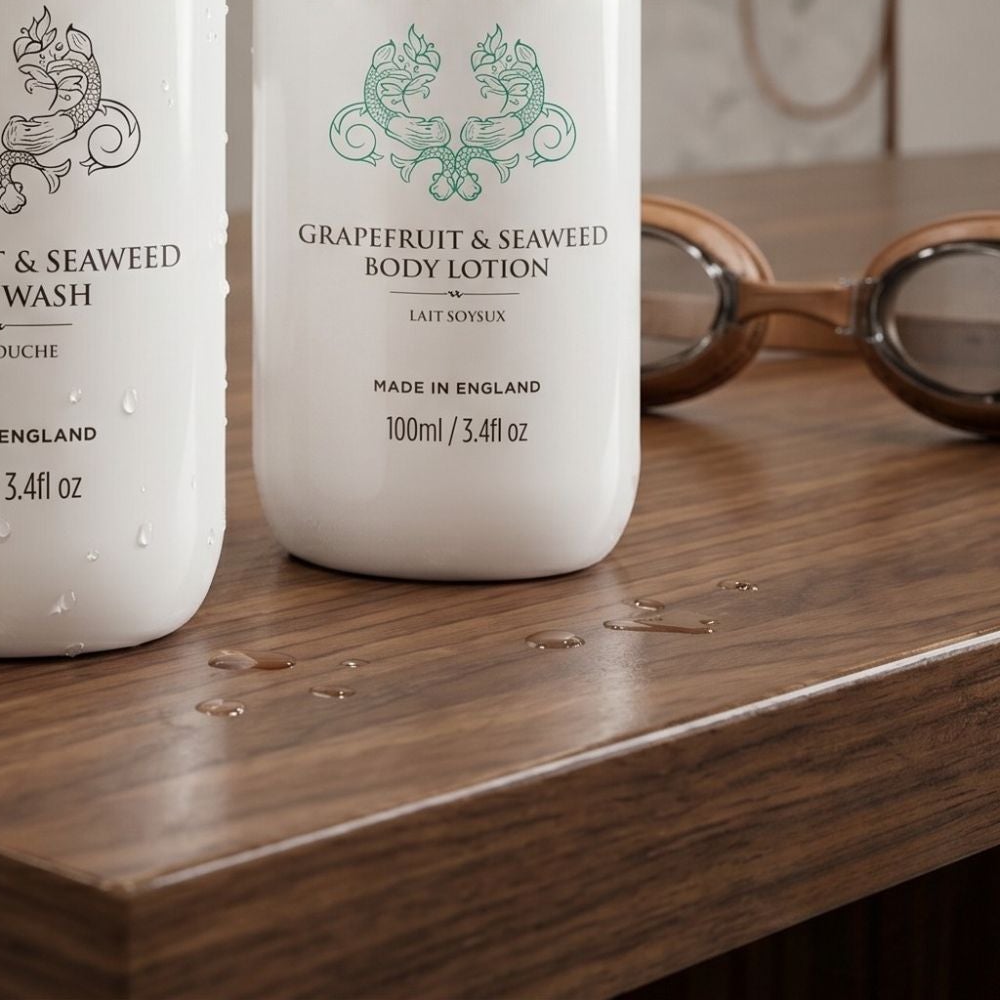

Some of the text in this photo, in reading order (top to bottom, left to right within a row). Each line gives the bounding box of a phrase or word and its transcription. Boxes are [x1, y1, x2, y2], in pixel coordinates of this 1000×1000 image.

[298, 224, 608, 251] GRAPEFRUIT & SEAWEED
[14, 249, 38, 273] &
[46, 244, 181, 273] SEAWEED
[364, 256, 549, 280] BODY LOTION
[2, 281, 92, 308] WASH
[410, 308, 506, 323] LAIT SOYSUX
[374, 378, 540, 395] MADE IN ENGLAND
[386, 416, 442, 442] 100ml
[462, 416, 503, 443] 3.4fl
[508, 423, 528, 442] oz
[5, 471, 50, 501] 3.4fl
[58, 477, 82, 499] oz
